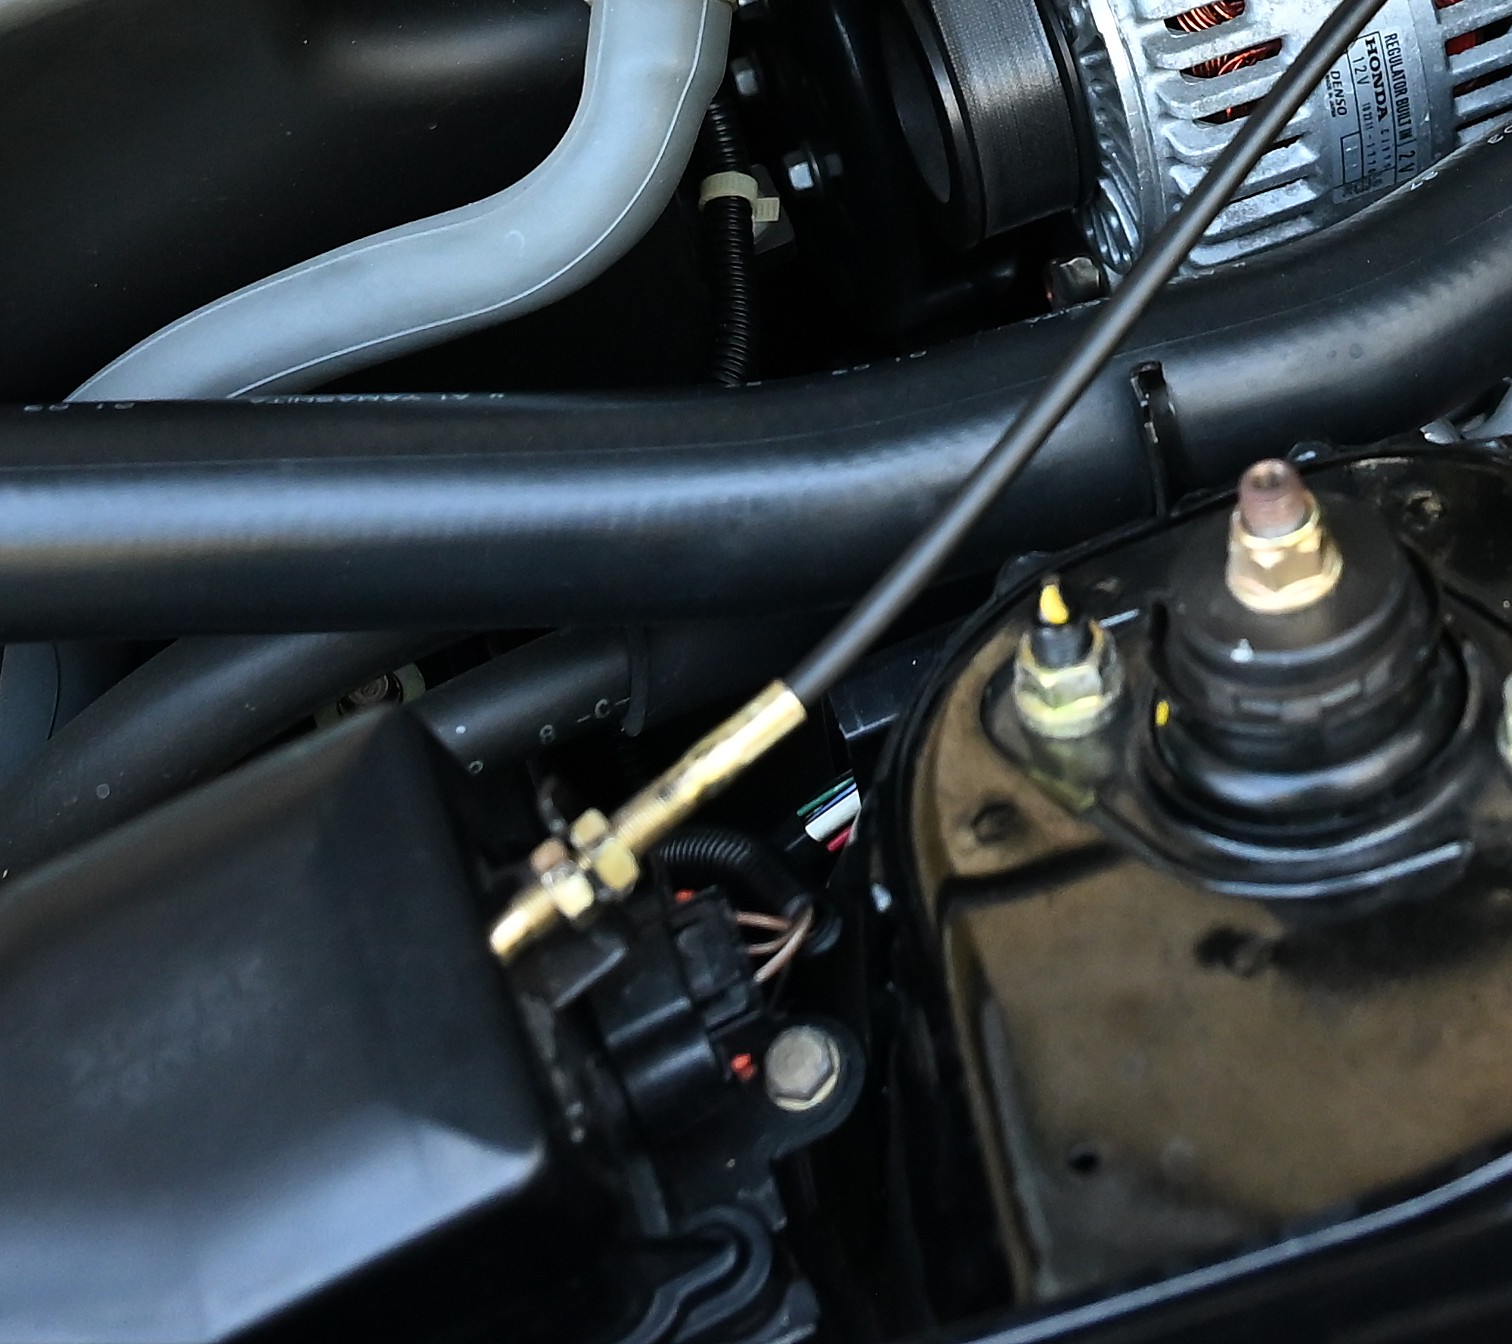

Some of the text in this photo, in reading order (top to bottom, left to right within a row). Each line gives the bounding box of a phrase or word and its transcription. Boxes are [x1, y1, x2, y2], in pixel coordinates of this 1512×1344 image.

[1352, 56, 1369, 86] 12V
[1363, 36, 1389, 122] HONDA
[1384, 33, 1408, 97] REGULATOR
[1329, 69, 1347, 116] DENSO
[1394, 97, 1412, 126] BUILT
